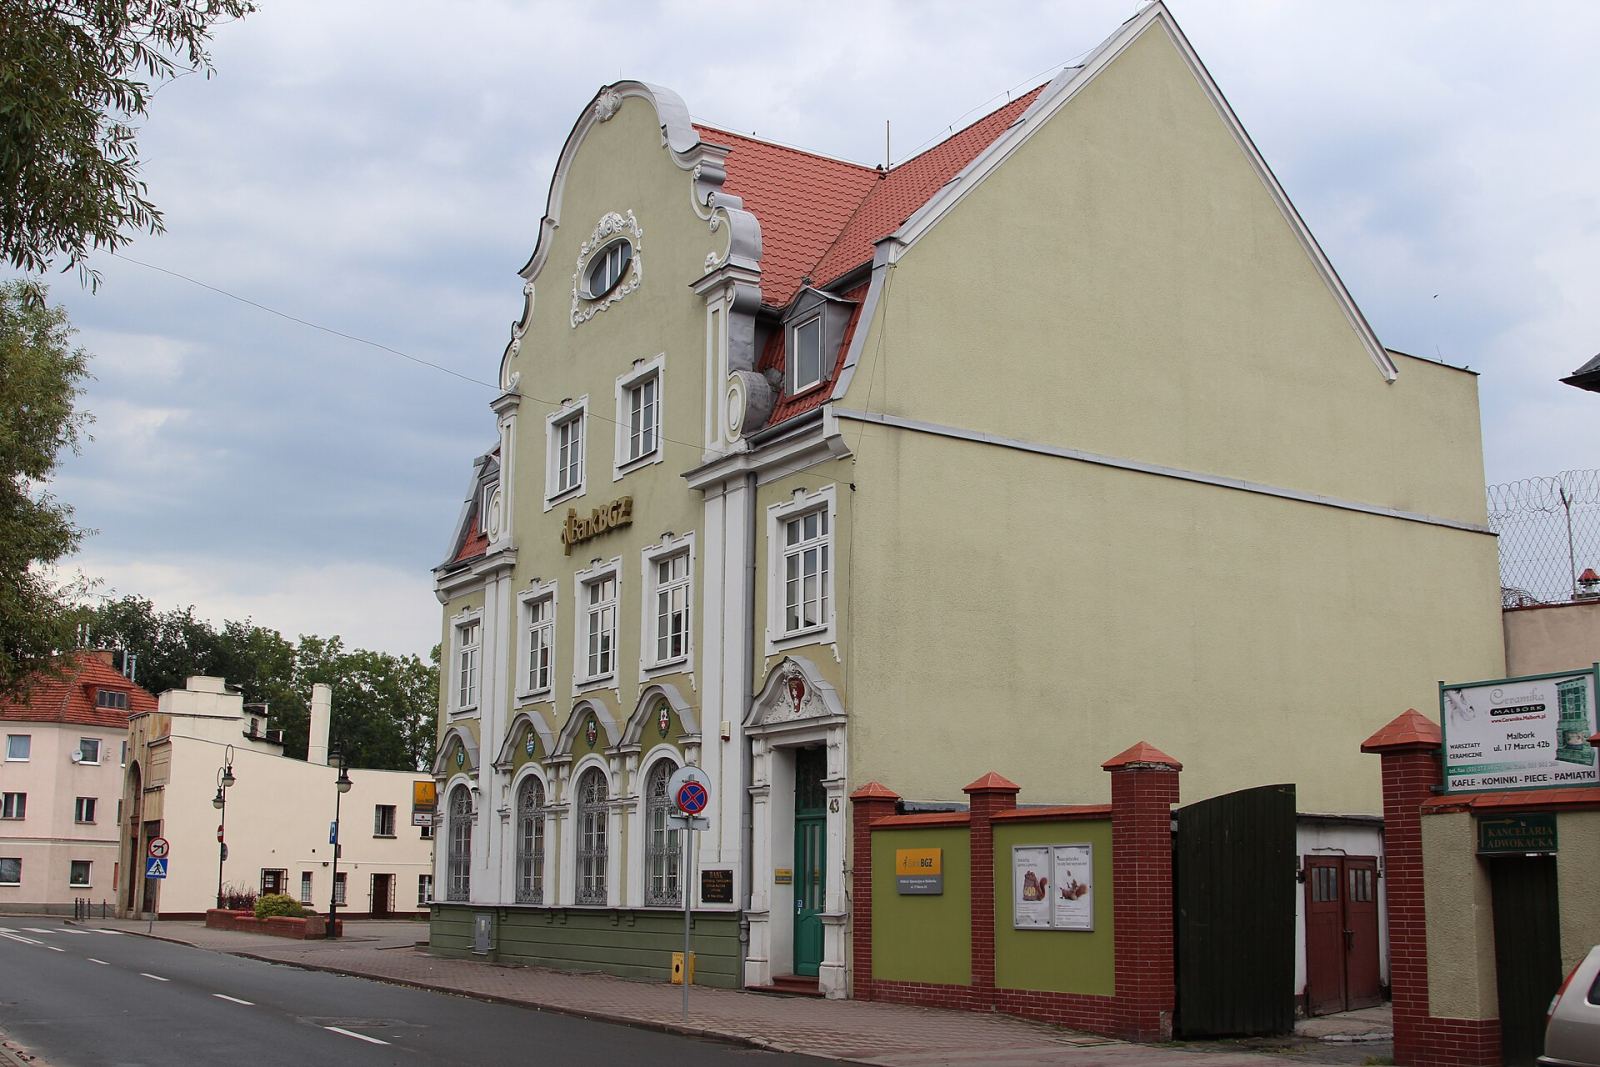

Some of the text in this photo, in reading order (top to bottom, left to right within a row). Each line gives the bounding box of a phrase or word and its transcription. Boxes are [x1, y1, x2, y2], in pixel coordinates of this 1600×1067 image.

[1490, 688, 1544, 705] Ceramika
[1493, 705, 1542, 714] MALBORK
[1506, 732, 1535, 740] Malbork
[1449, 752, 1482, 760] CERAMICZNE
[1452, 779, 1476, 787] KAFLE
[1482, 776, 1518, 785] KOMINKI
[1524, 774, 1547, 783] PIECE
[1554, 770, 1596, 781] PAMIĄTKI
[829, 799, 840, 814] 43
[1488, 826, 1553, 836] KANCELARIA
[1487, 838, 1553, 848] ADWOKACKA
